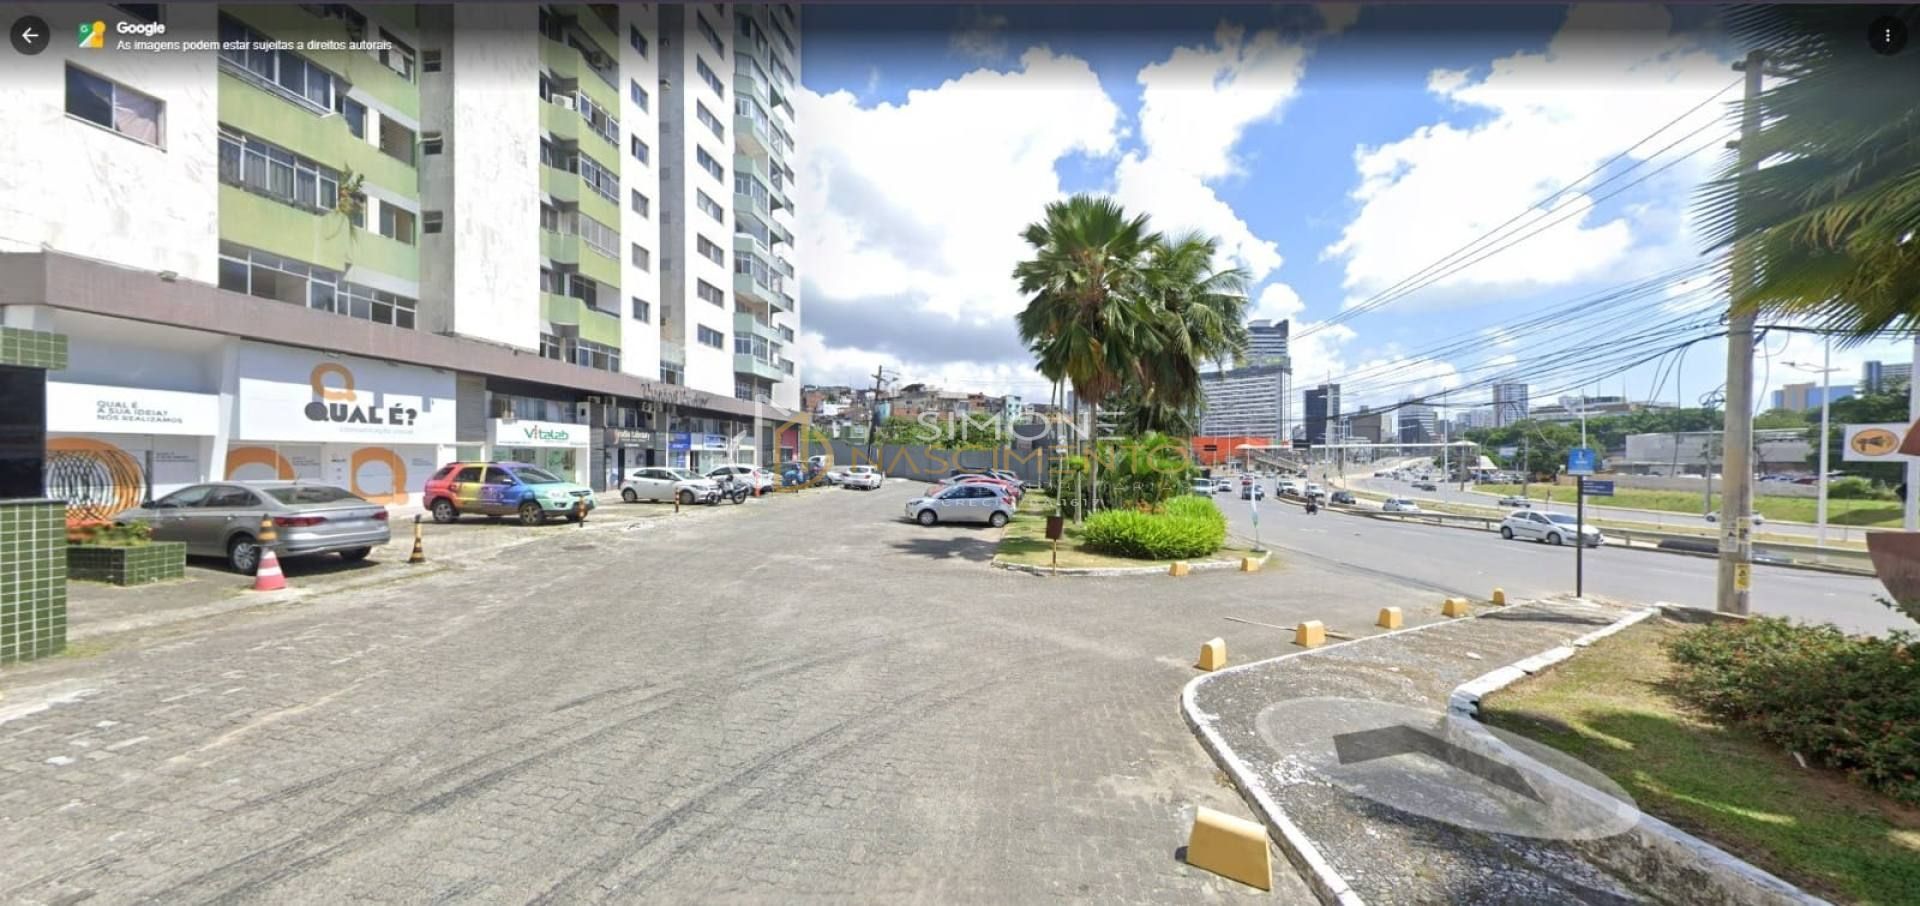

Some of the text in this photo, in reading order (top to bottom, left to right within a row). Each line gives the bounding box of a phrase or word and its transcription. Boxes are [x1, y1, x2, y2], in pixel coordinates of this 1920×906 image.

[97, 400, 127, 409] QUAL
[304, 401, 418, 426] QUAL É?
[524, 424, 569, 440] Vitalab
